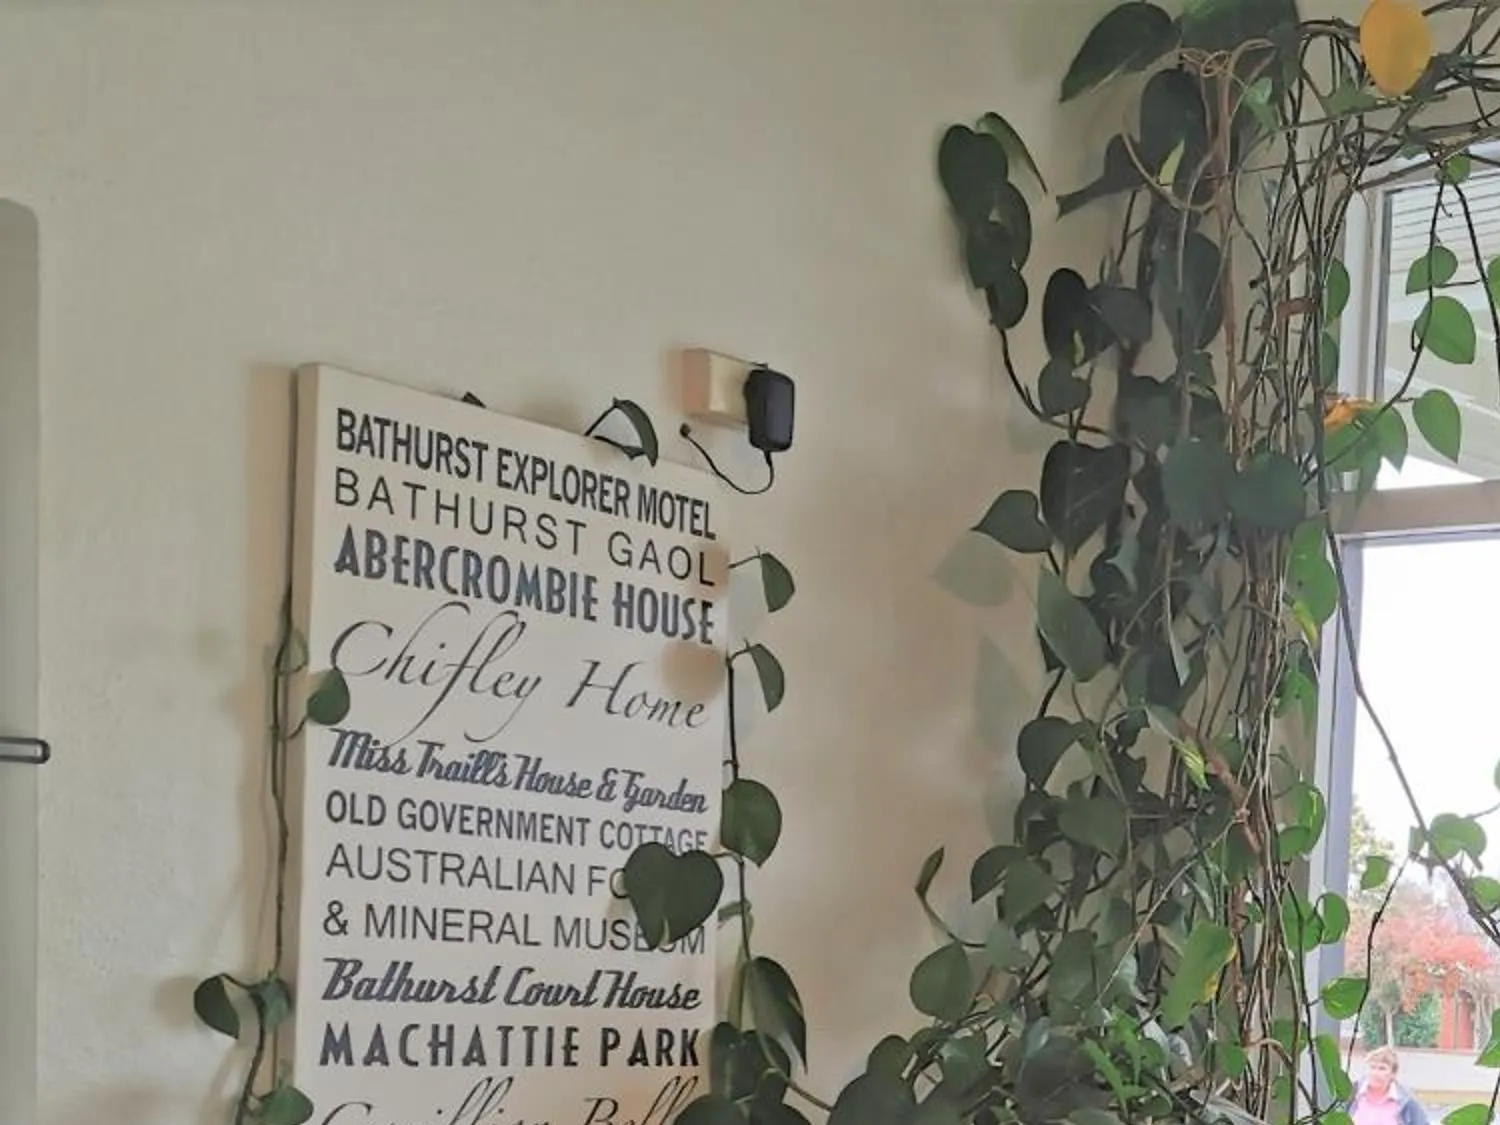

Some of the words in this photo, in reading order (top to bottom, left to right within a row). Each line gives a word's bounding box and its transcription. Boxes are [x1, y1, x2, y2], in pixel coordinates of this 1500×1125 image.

[336, 408, 488, 482] BATHURST
[499, 448, 631, 518] EXPLORER
[637, 484, 716, 540] MOTEL
[335, 468, 586, 556] BATHURST
[608, 531, 715, 586] GAOL
[334, 524, 598, 622] ABERCROMBIE
[613, 582, 713, 645] HOUSE
[330, 602, 541, 748] Chifley
[565, 659, 710, 730] Home
[328, 728, 411, 774] Miss
[513, 754, 593, 798] House
[595, 767, 619, 801] &
[621, 769, 708, 813] Garden
[326, 790, 386, 826] OLD
[397, 798, 591, 847] GOVERNMENT
[600, 819, 708, 853] COTTAGE
[325, 843, 575, 895] AUSTRALIAN
[323, 900, 348, 936] &
[365, 904, 540, 947] MINERAL
[554, 915, 705, 955] MUSEM
[322, 958, 501, 1005] Bathurst
[505, 967, 601, 1008] Court
[602, 970, 702, 1010] House
[319, 1022, 580, 1067] MACHATTIE
[600, 1027, 700, 1067] PARK
